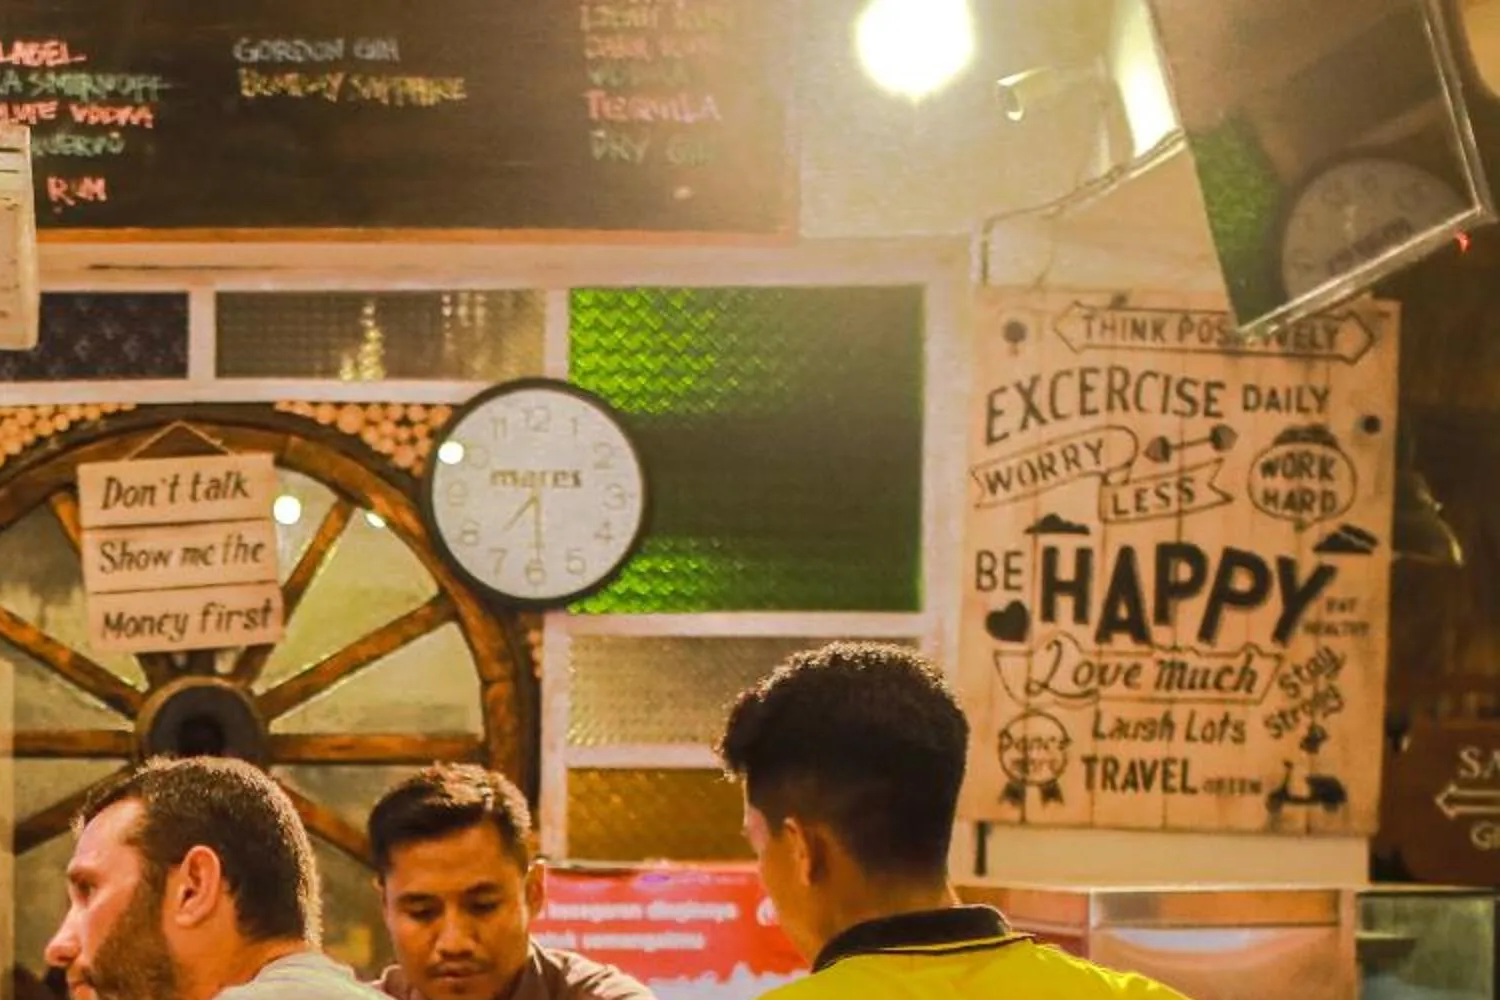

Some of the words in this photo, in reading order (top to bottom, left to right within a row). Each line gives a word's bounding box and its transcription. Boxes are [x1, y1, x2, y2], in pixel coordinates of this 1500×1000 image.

[1082, 314, 1167, 343] THINK
[985, 366, 1227, 446] EXCERCISE
[1242, 383, 1332, 415] DAILY
[983, 436, 1105, 498] WORRY
[1259, 455, 1338, 484] WORK
[100, 475, 180, 510] Don't
[189, 470, 250, 502] talk
[1111, 476, 1196, 518] LESS
[1262, 486, 1338, 515] HARD
[100, 540, 173, 575] Show
[975, 549, 1025, 593] BE
[1040, 542, 1339, 648] HAPPY
[101, 608, 190, 643] Money
[200, 598, 275, 634] first
[1025, 638, 1144, 699] Love
[1091, 708, 1175, 743] Laugh
[1184, 708, 1247, 744] Lots
[1081, 754, 1199, 796] TRAVEL
